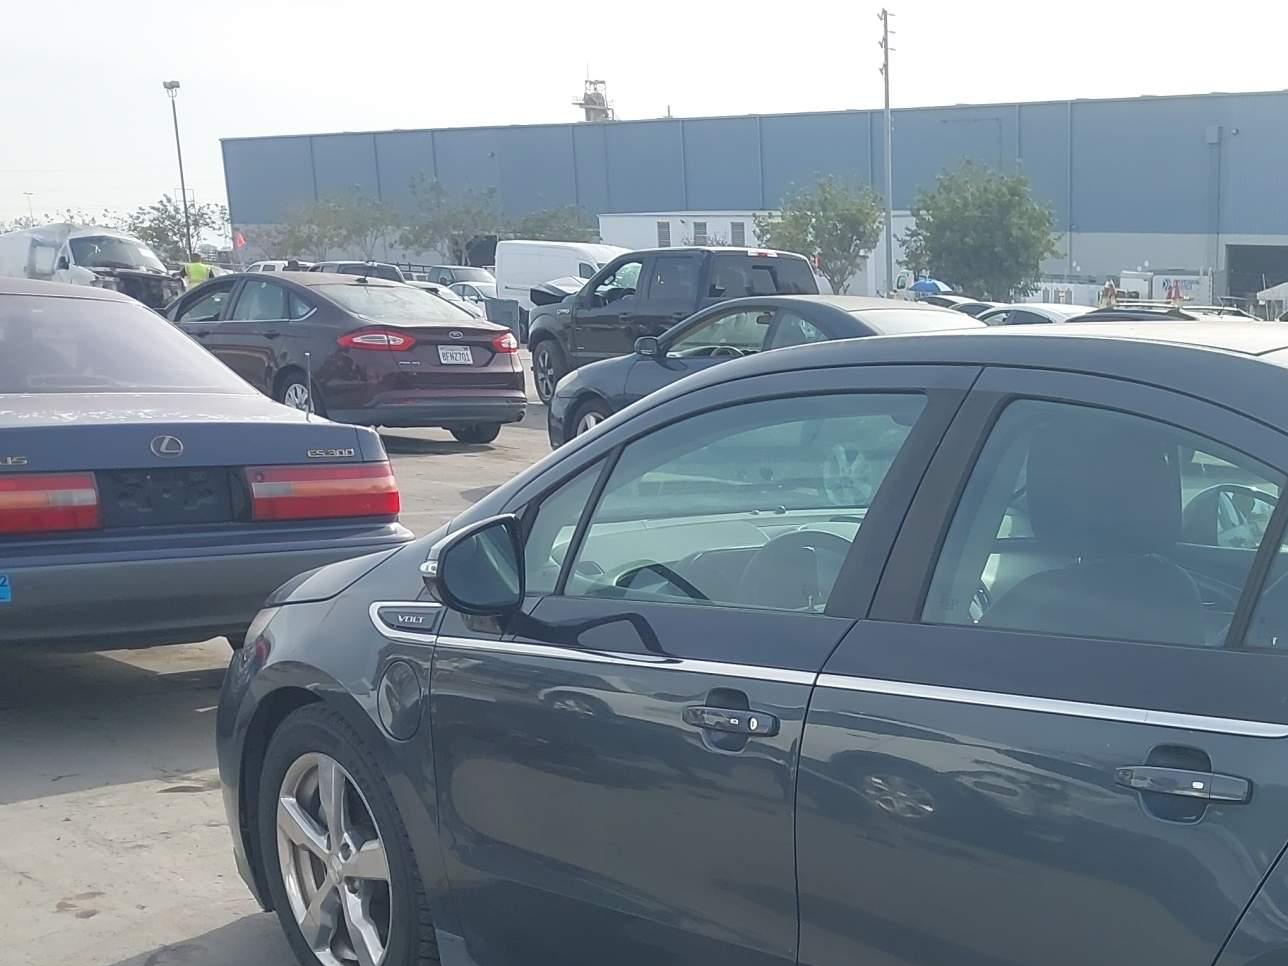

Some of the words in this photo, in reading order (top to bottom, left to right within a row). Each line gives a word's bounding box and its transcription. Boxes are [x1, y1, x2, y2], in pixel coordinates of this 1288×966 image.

[307, 449, 326, 457] ES
[327, 448, 354, 457] 300
[398, 615, 425, 623] VOLT
